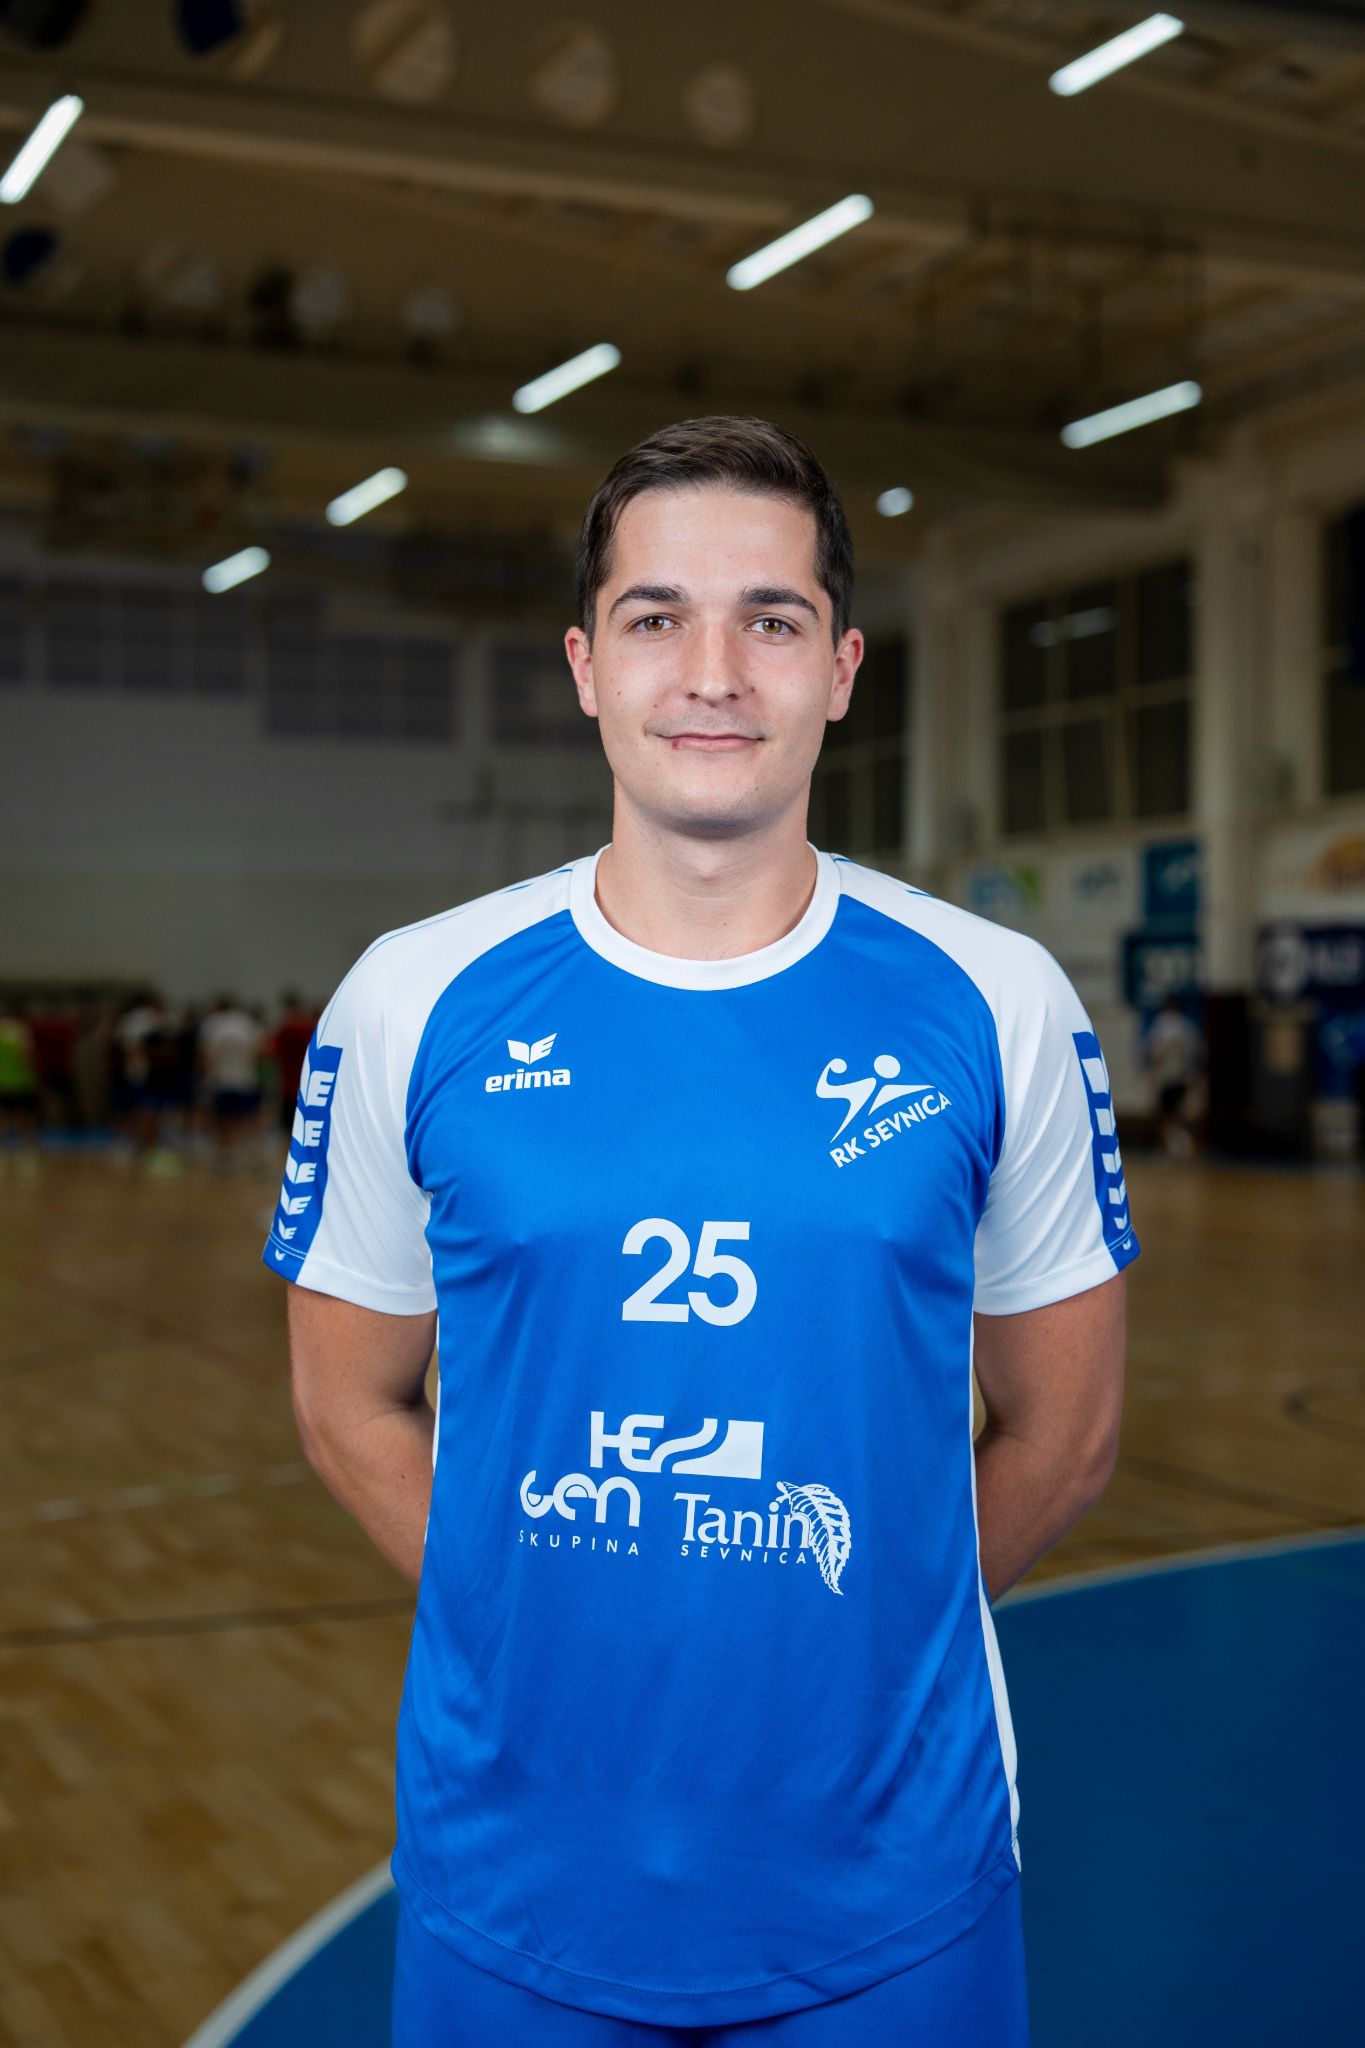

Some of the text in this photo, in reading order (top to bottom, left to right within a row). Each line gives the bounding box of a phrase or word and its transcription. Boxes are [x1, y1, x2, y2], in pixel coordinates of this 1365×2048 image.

[485, 1068, 571, 1093] erima
[829, 1091, 952, 1168] RK SEVNICA
[621, 1217, 758, 1327] 25
[673, 1492, 812, 1549] Tanin
[518, 1529, 639, 1556] SKUPINA
[680, 1544, 807, 1564] SEVNICA
